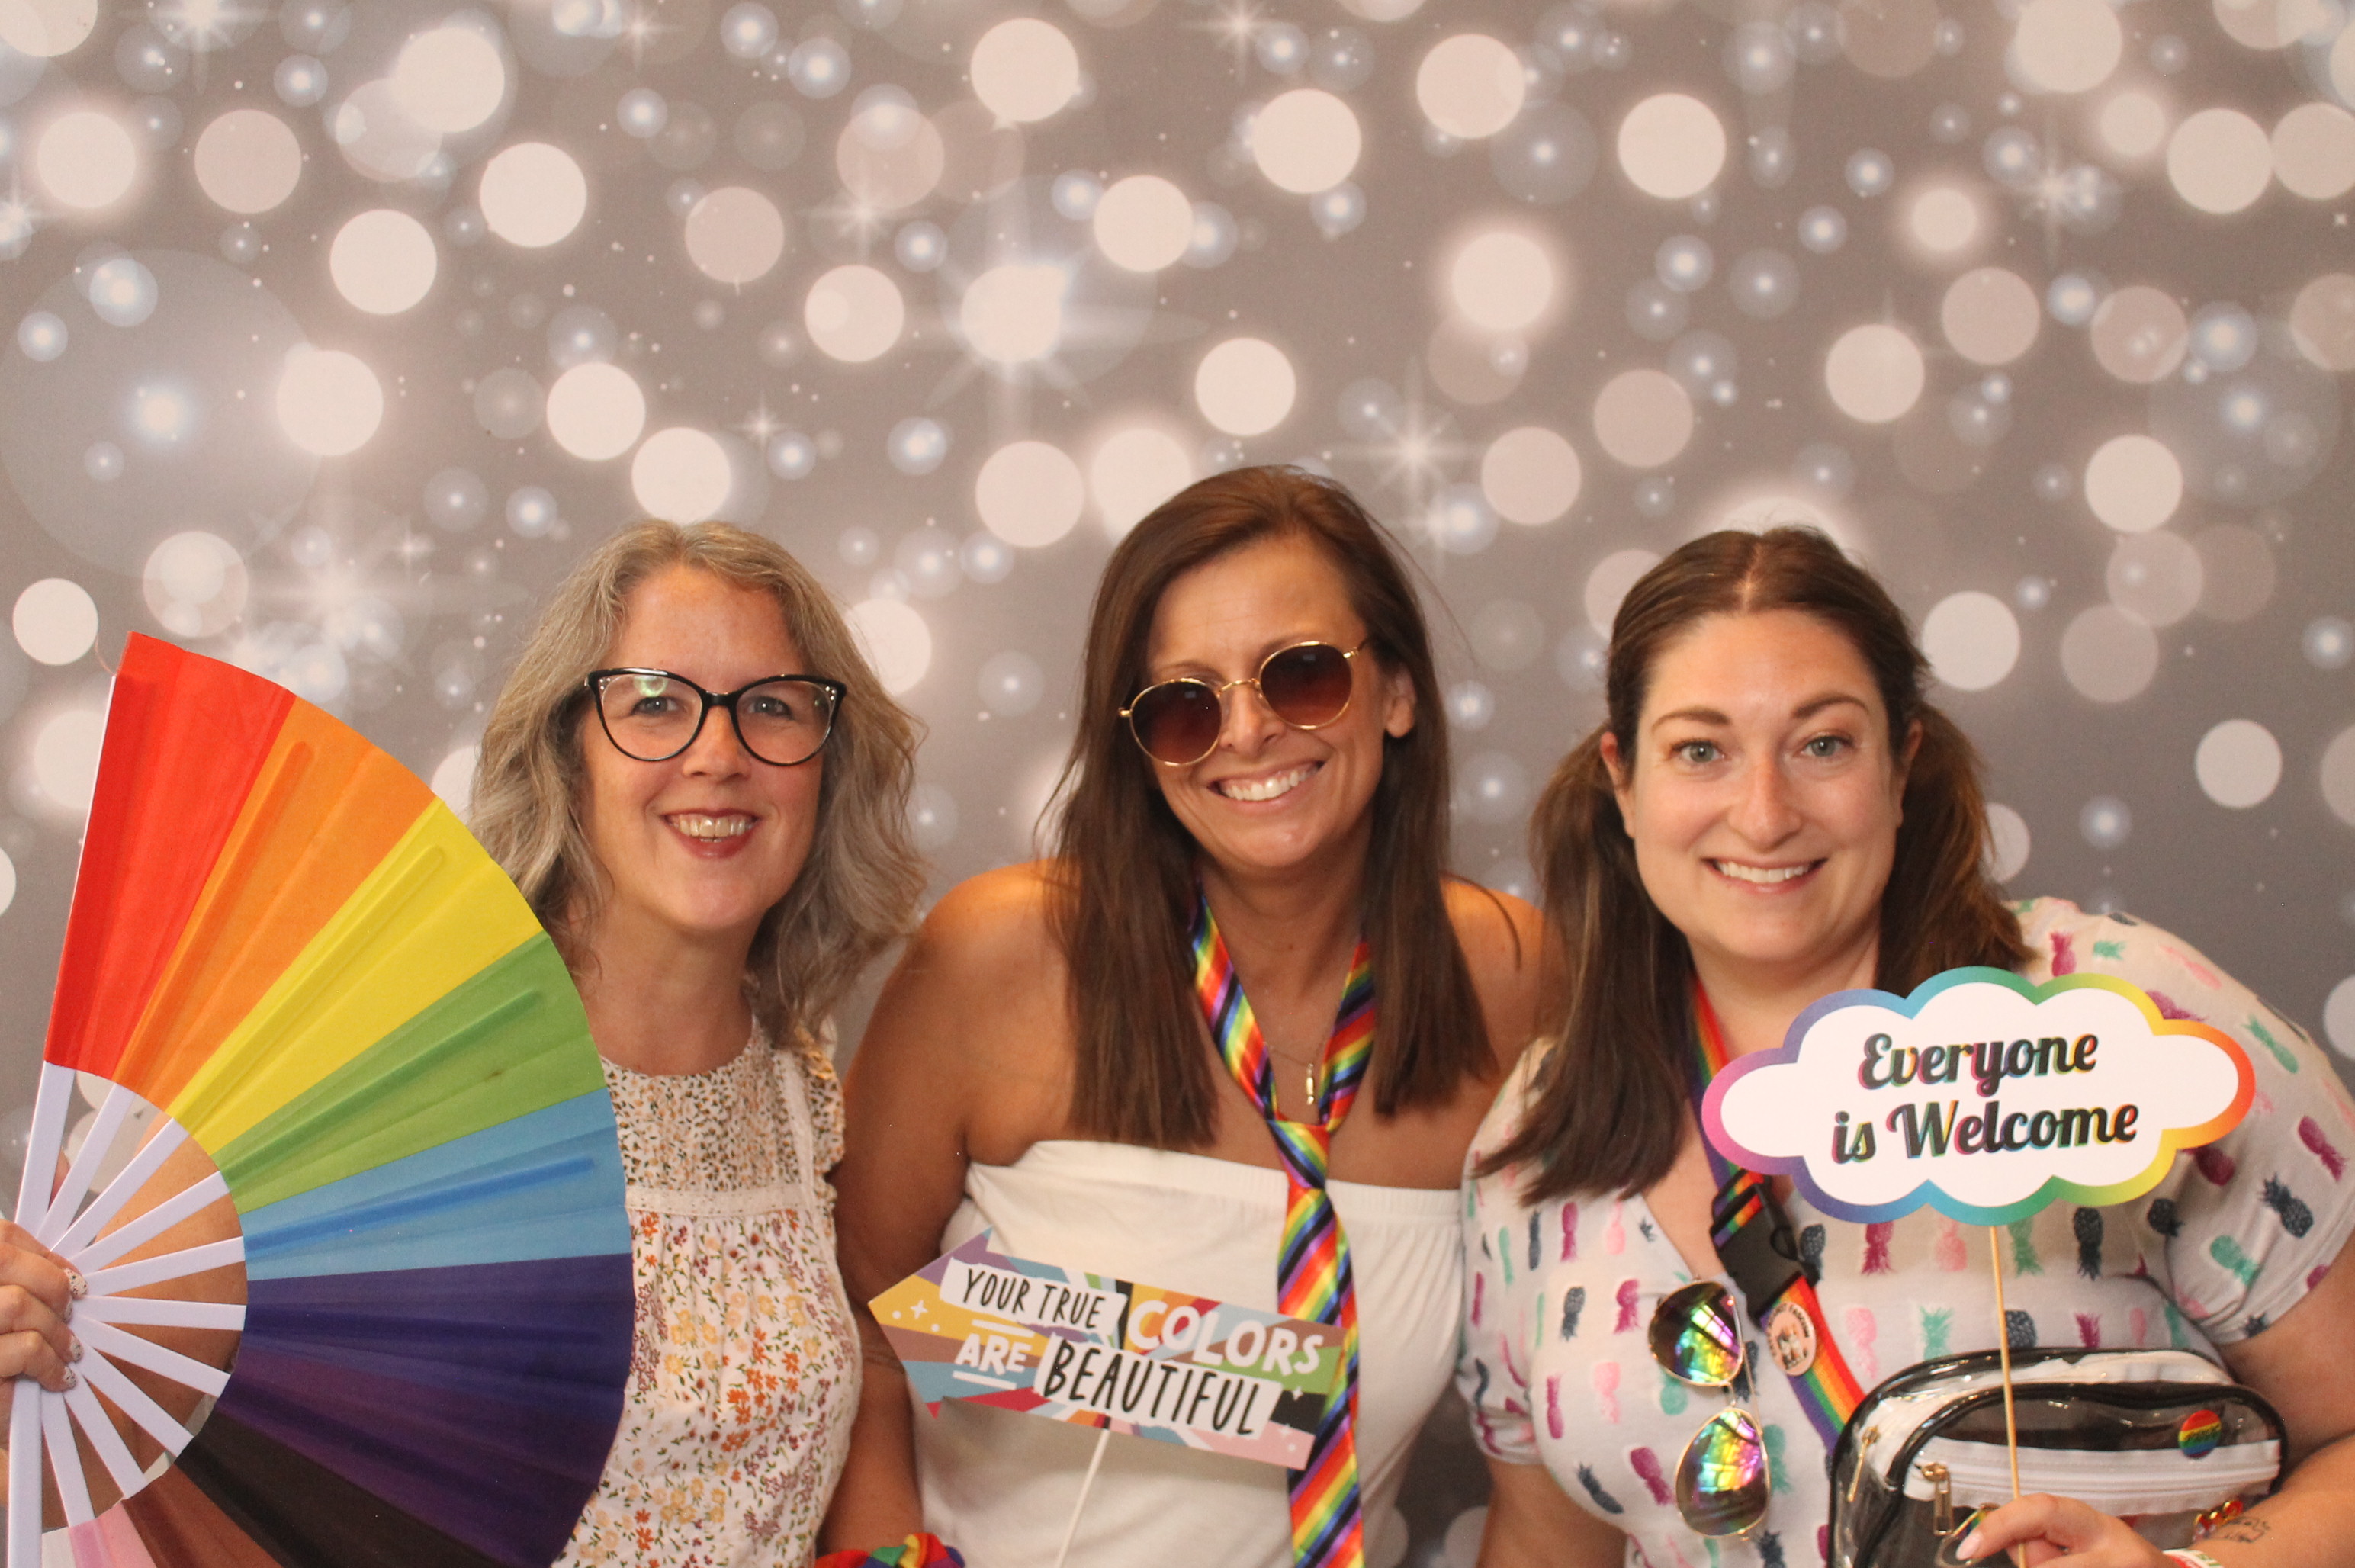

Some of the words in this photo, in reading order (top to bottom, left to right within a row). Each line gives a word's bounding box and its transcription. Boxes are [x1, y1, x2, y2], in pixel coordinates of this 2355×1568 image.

[1858, 1033, 2099, 1097] Everyone
[1831, 1111, 1877, 1164] is
[1886, 1100, 2139, 1158] Welcome
[962, 1267, 1030, 1314] YOUR
[1038, 1283, 1107, 1329] TRUE
[1126, 1299, 1325, 1376] COLORS
[954, 1333, 1033, 1375] ARE
[1043, 1339, 1260, 1436] BEAUTIFUL
